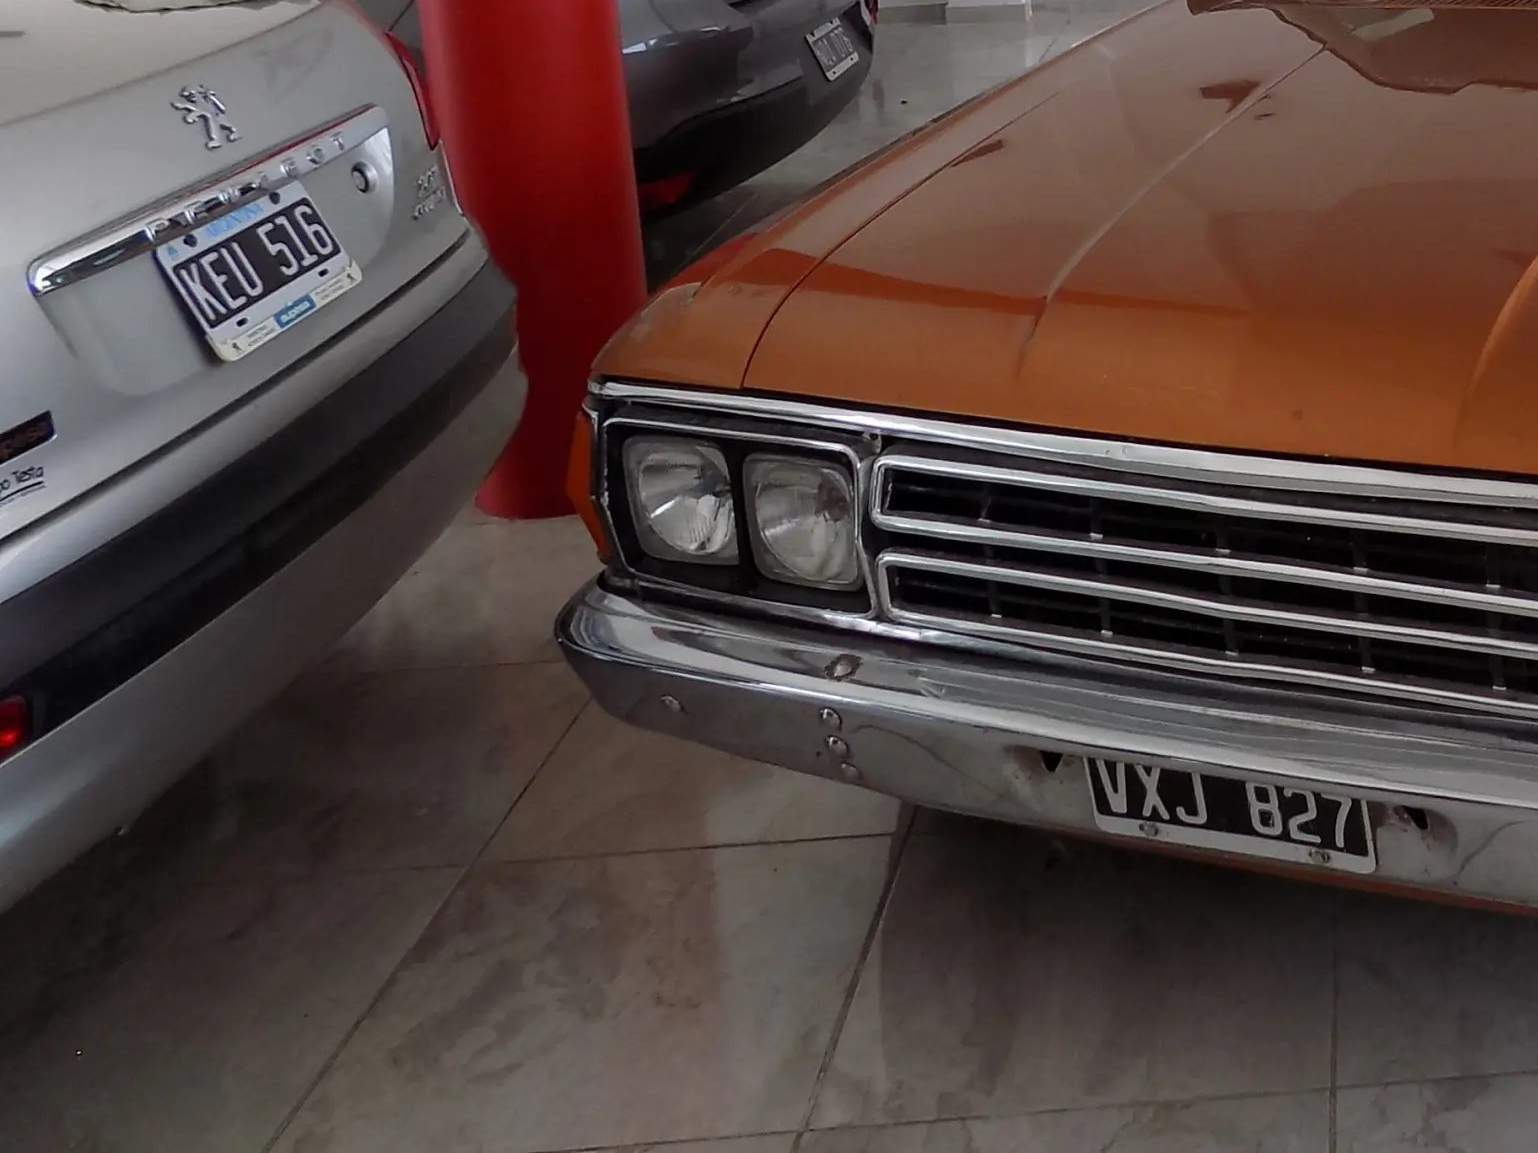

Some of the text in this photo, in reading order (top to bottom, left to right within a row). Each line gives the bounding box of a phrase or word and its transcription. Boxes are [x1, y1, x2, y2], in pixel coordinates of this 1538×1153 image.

[179, 242, 264, 321] KEU
[256, 204, 334, 277] 516
[1095, 758, 1353, 849] VXJ 827
